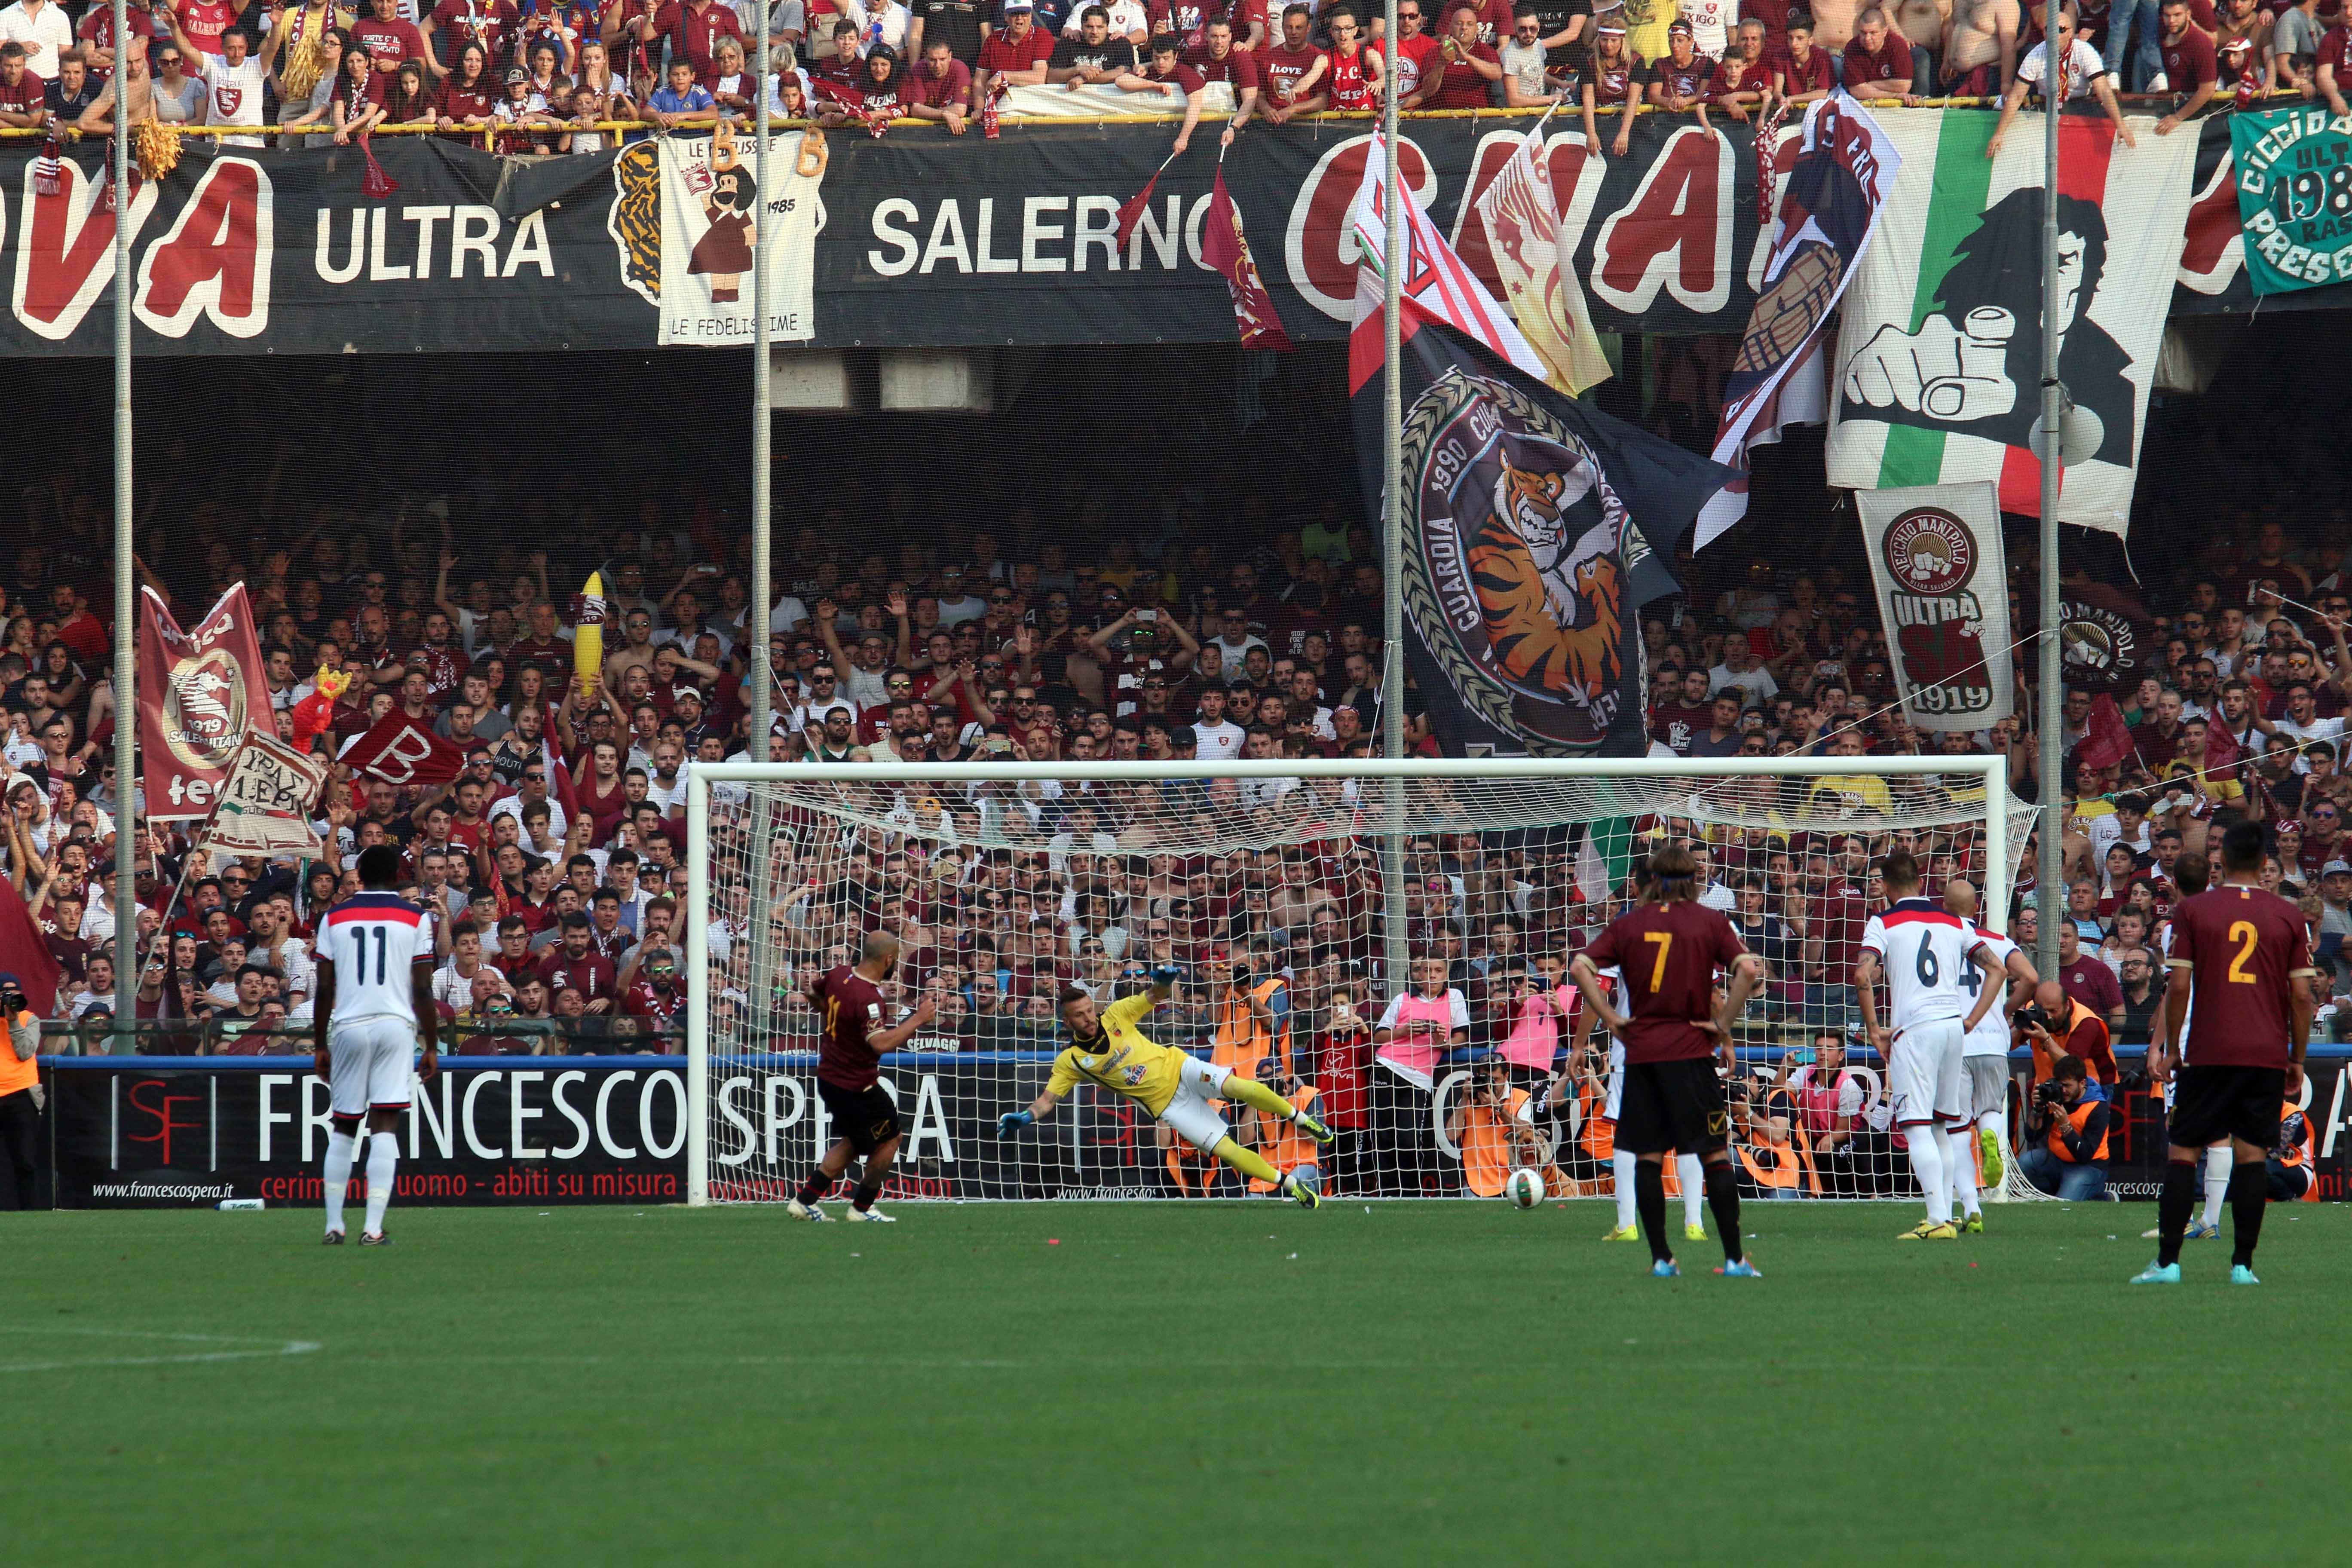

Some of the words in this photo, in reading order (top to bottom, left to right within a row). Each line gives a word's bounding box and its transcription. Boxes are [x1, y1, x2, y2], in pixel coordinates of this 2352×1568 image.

[767, 199, 796, 215] 1985
[671, 318, 688, 335] LE
[697, 313, 798, 336] FEDELISIME
[1894, 521, 1917, 575] VECCHIO
[1918, 518, 1966, 565] MANIPOLO
[187, 718, 222, 733] 1919
[1908, 683, 1990, 712] 1919
[366, 725, 432, 785] B
[351, 926, 386, 986] 11
[1644, 932, 1673, 993] 7
[1917, 929, 1939, 988] 6
[2228, 920, 2258, 984] 2
[260, 1070, 687, 1162] FRNCESCO
[718, 1075, 954, 1165] SPA
[92, 1182, 233, 1201] www.francescospera.it
[261, 1172, 369, 1200] cerimni
[397, 1176, 467, 1197] uomo
[493, 1166, 548, 1197] abiti
[557, 1175, 584, 1196] su
[592, 1167, 676, 1197] misura
